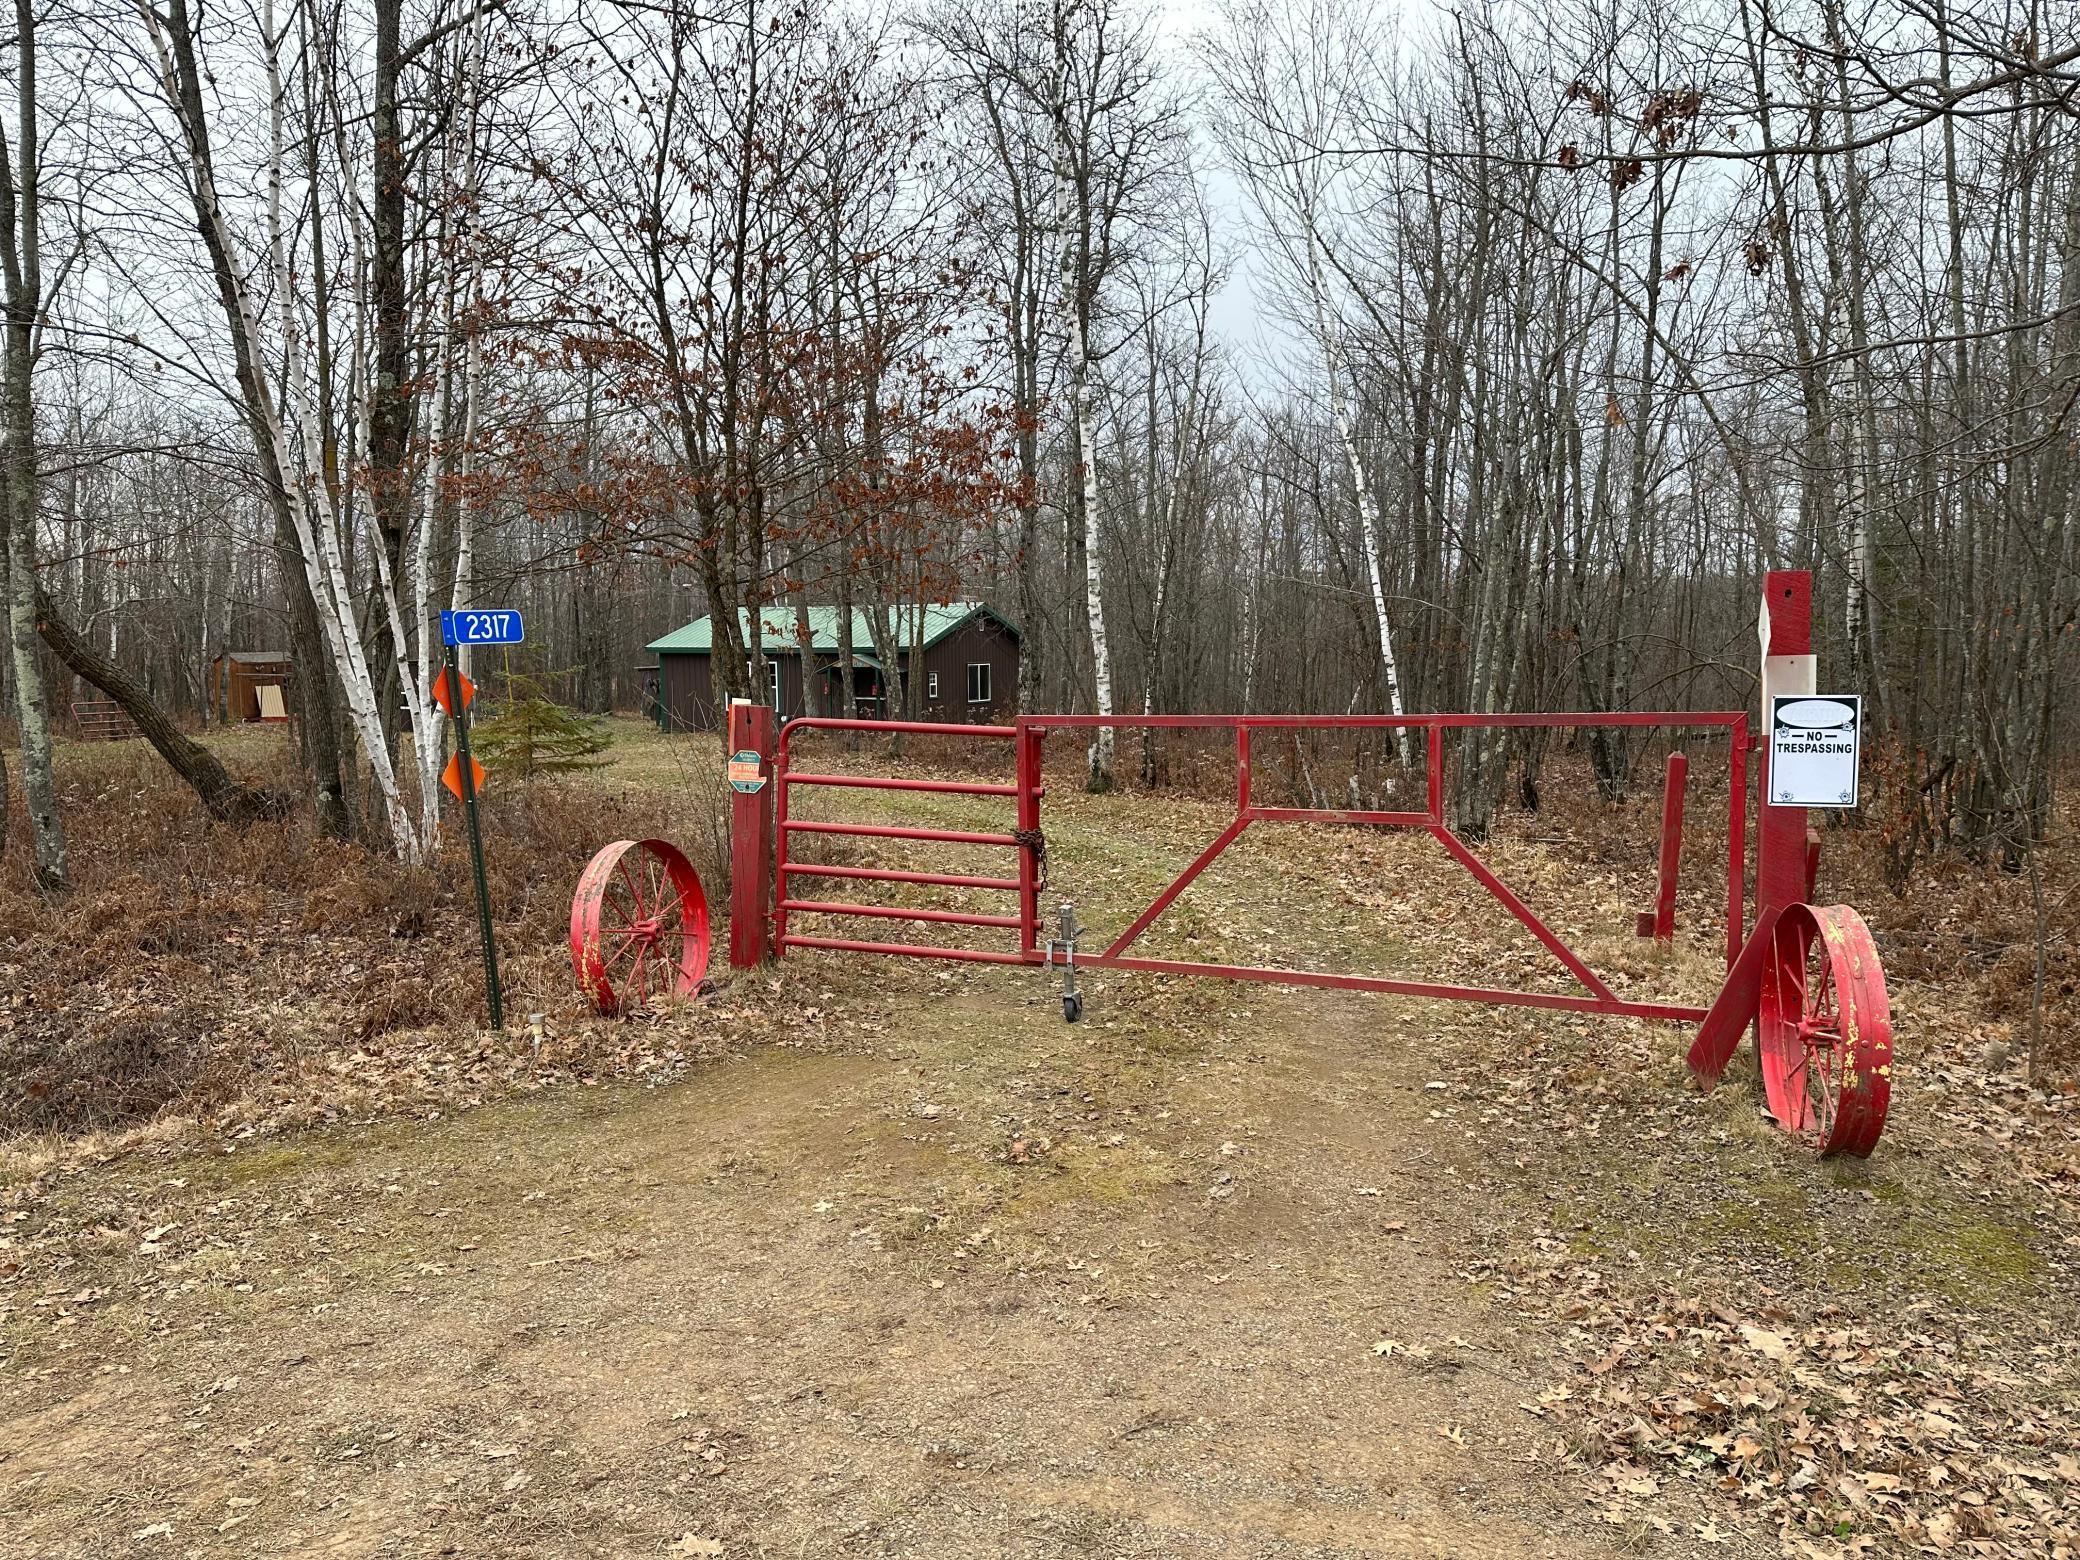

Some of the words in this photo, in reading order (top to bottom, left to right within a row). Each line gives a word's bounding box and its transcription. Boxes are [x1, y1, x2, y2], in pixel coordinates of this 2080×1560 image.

[466, 614, 510, 639] 2317
[1807, 732, 1822, 741] NO
[1776, 744, 1852, 753] TRESPASSING
